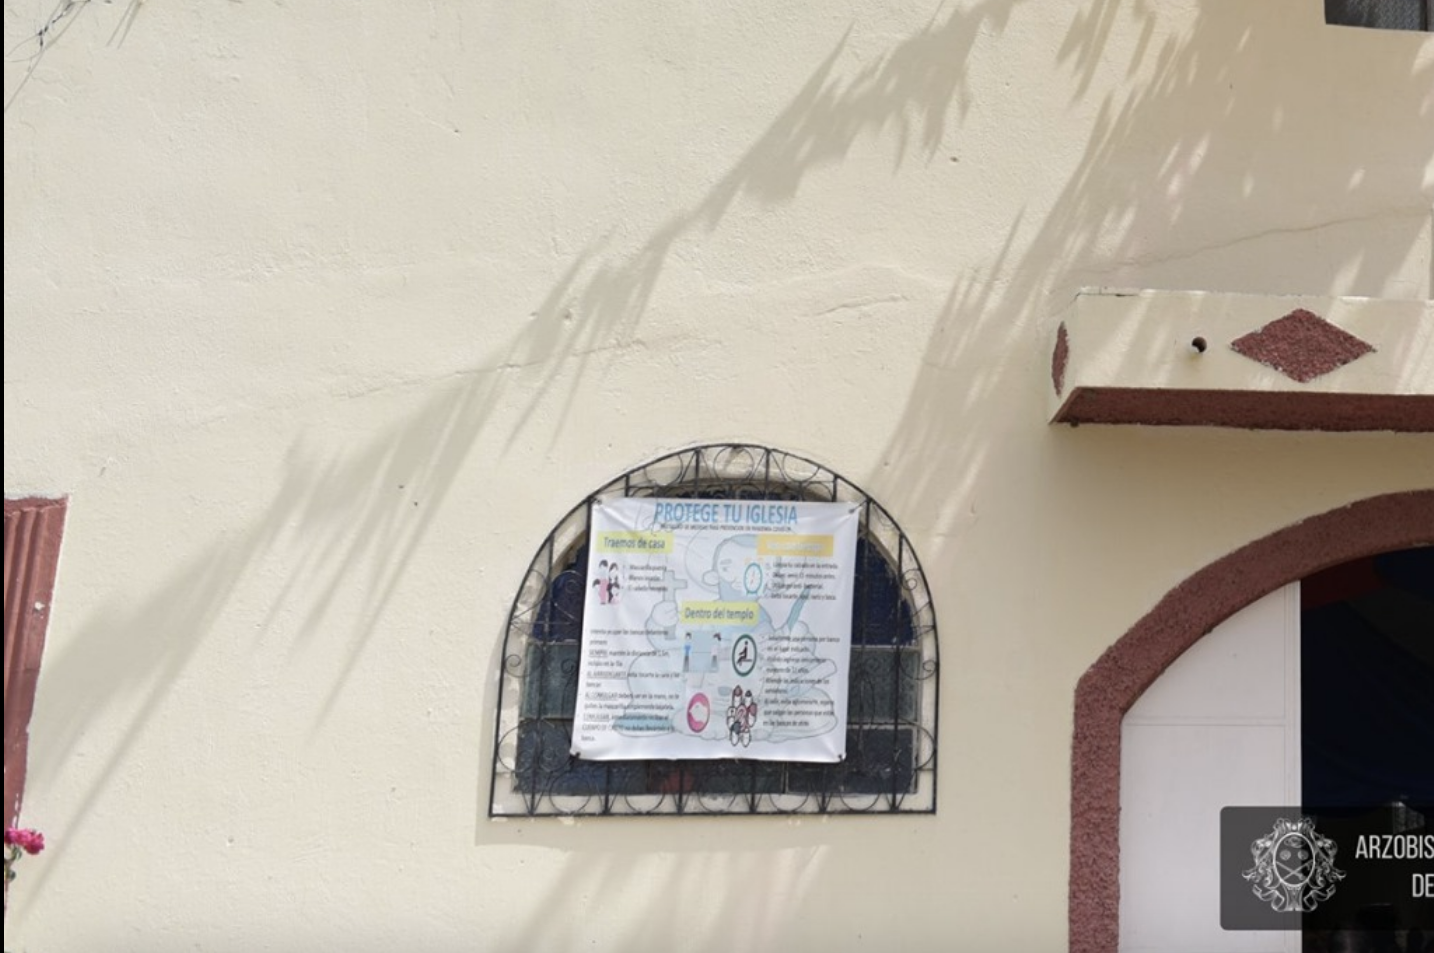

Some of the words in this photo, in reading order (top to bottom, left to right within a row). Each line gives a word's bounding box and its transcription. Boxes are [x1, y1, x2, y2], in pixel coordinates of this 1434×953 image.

[654, 502, 719, 523] PROTEGE
[722, 504, 742, 523] TU
[745, 504, 798, 524] IGLESIA
[604, 536, 635, 548] Traemos
[637, 536, 647, 549] de
[648, 539, 665, 549] casa
[684, 607, 711, 619] Dentro
[713, 607, 725, 619] del
[727, 608, 754, 622] templo
